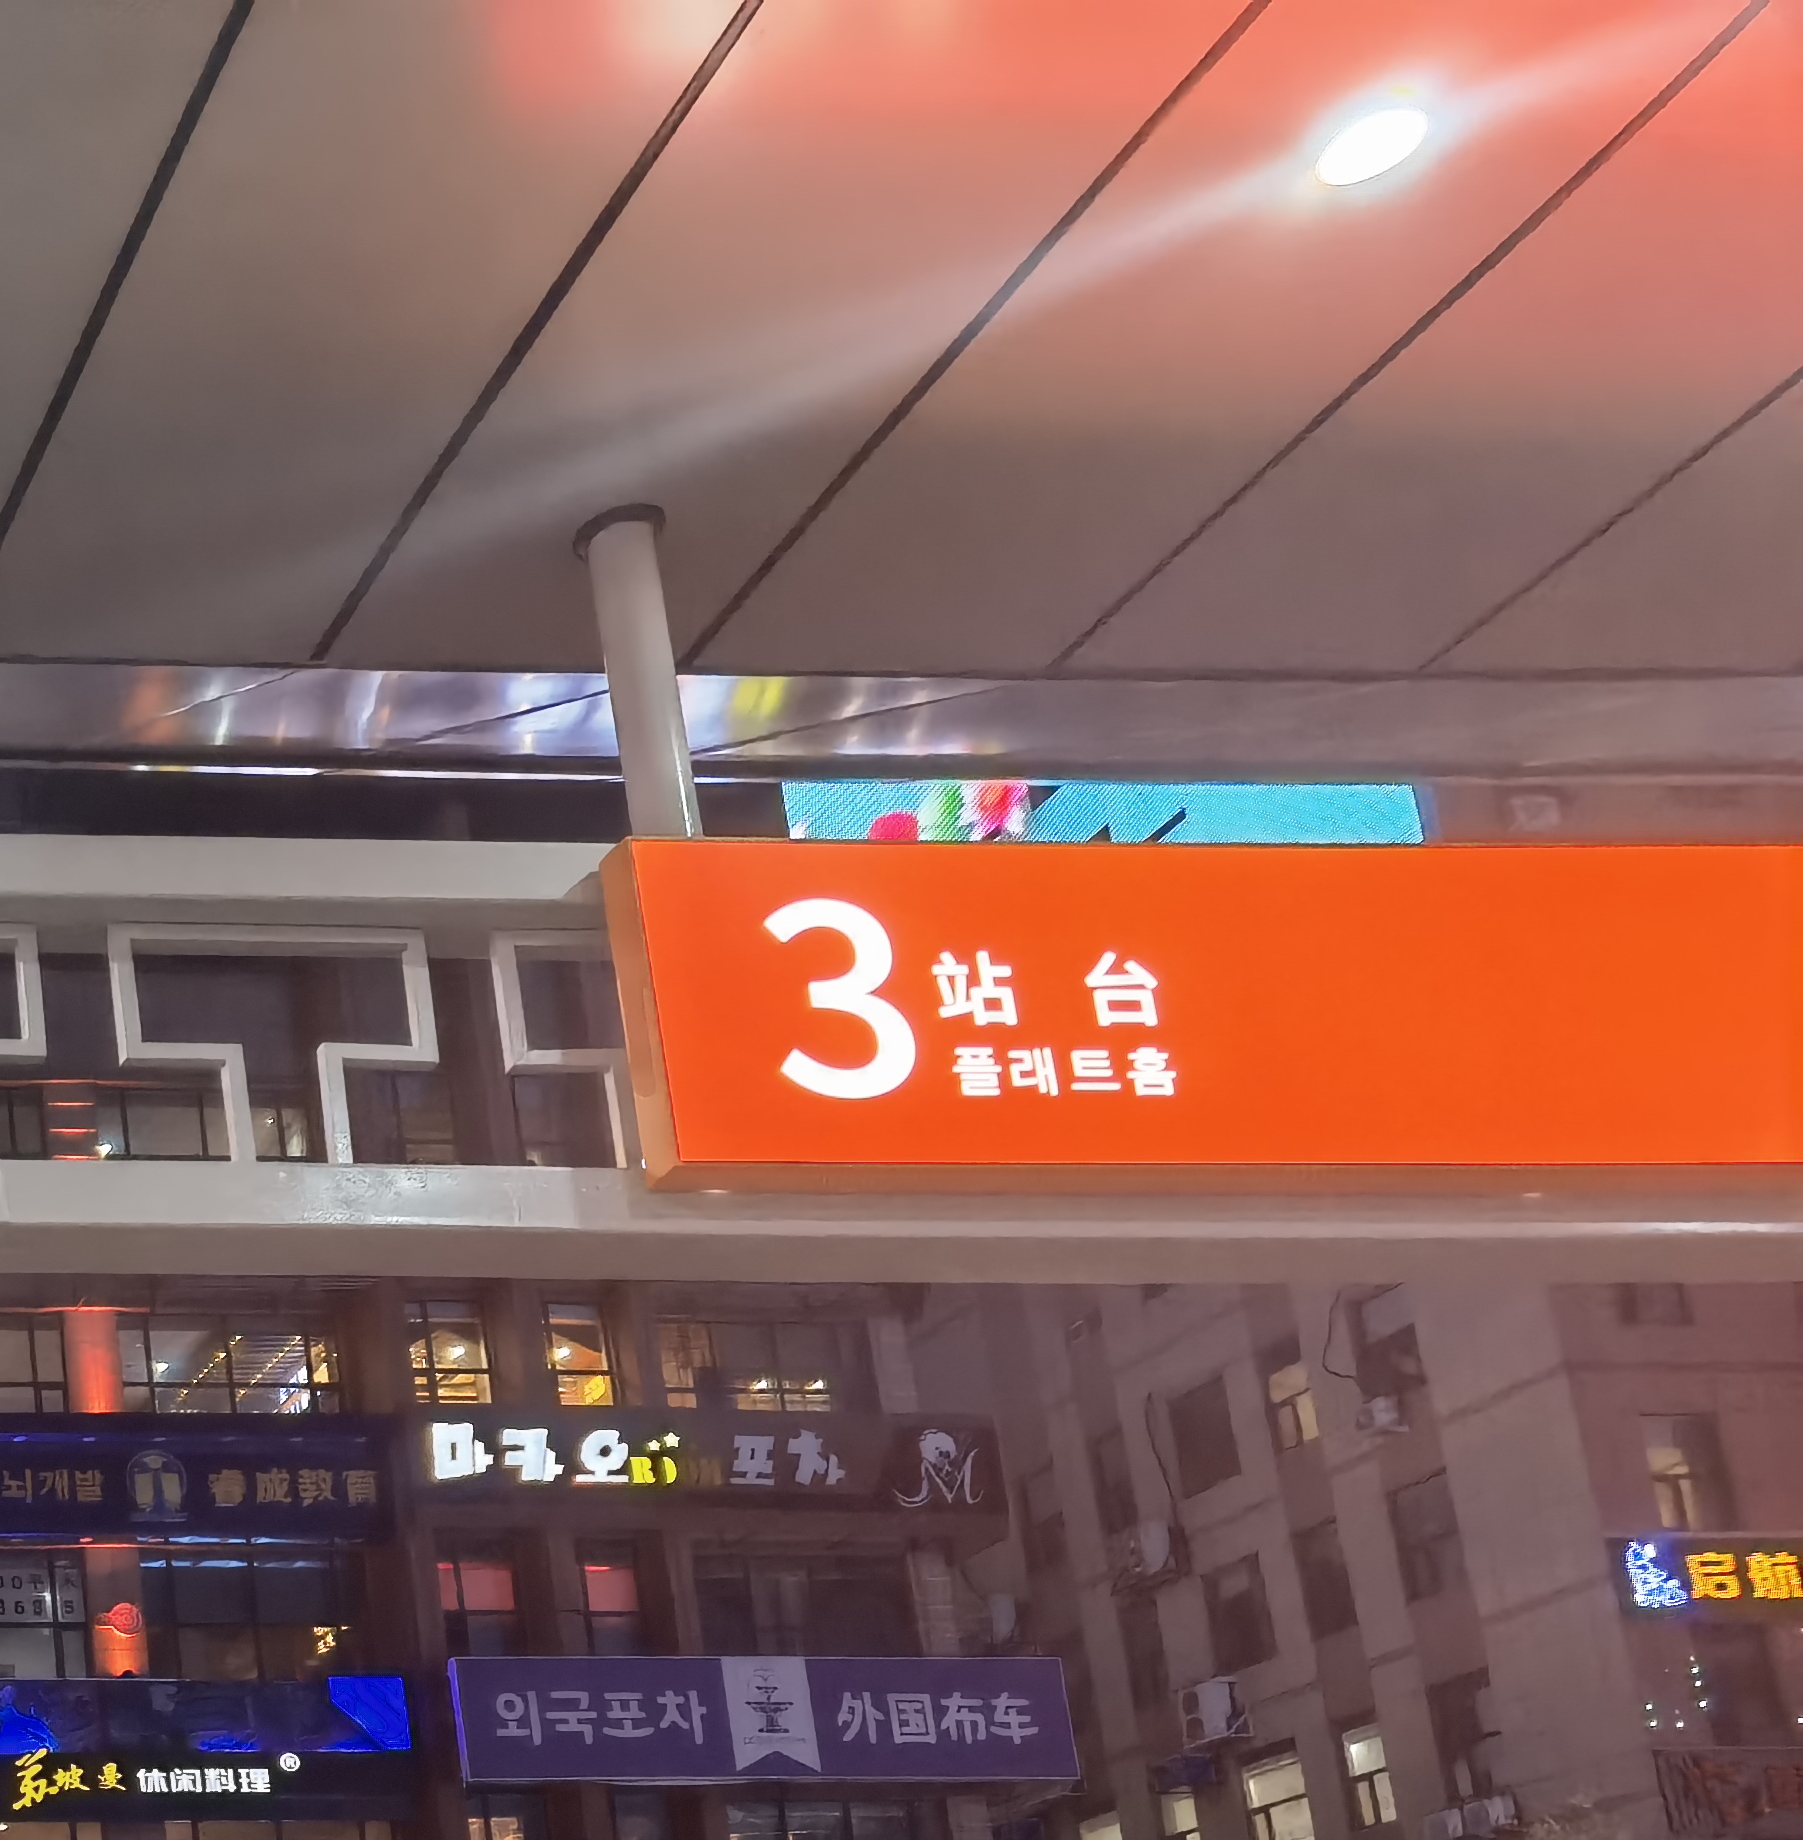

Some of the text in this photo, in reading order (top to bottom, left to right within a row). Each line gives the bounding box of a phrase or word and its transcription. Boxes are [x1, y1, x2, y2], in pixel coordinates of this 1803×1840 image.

[761, 896, 919, 1100] 3
[931, 950, 1160, 1028] 站台
[951, 1046, 1179, 1098] 플래트홈
[431, 1421, 629, 1484] 마카오
[495, 1690, 707, 1744] 외국포차
[838, 1691, 1040, 1744] 外国布车
[136, 1768, 271, 1793] 休闲料理
